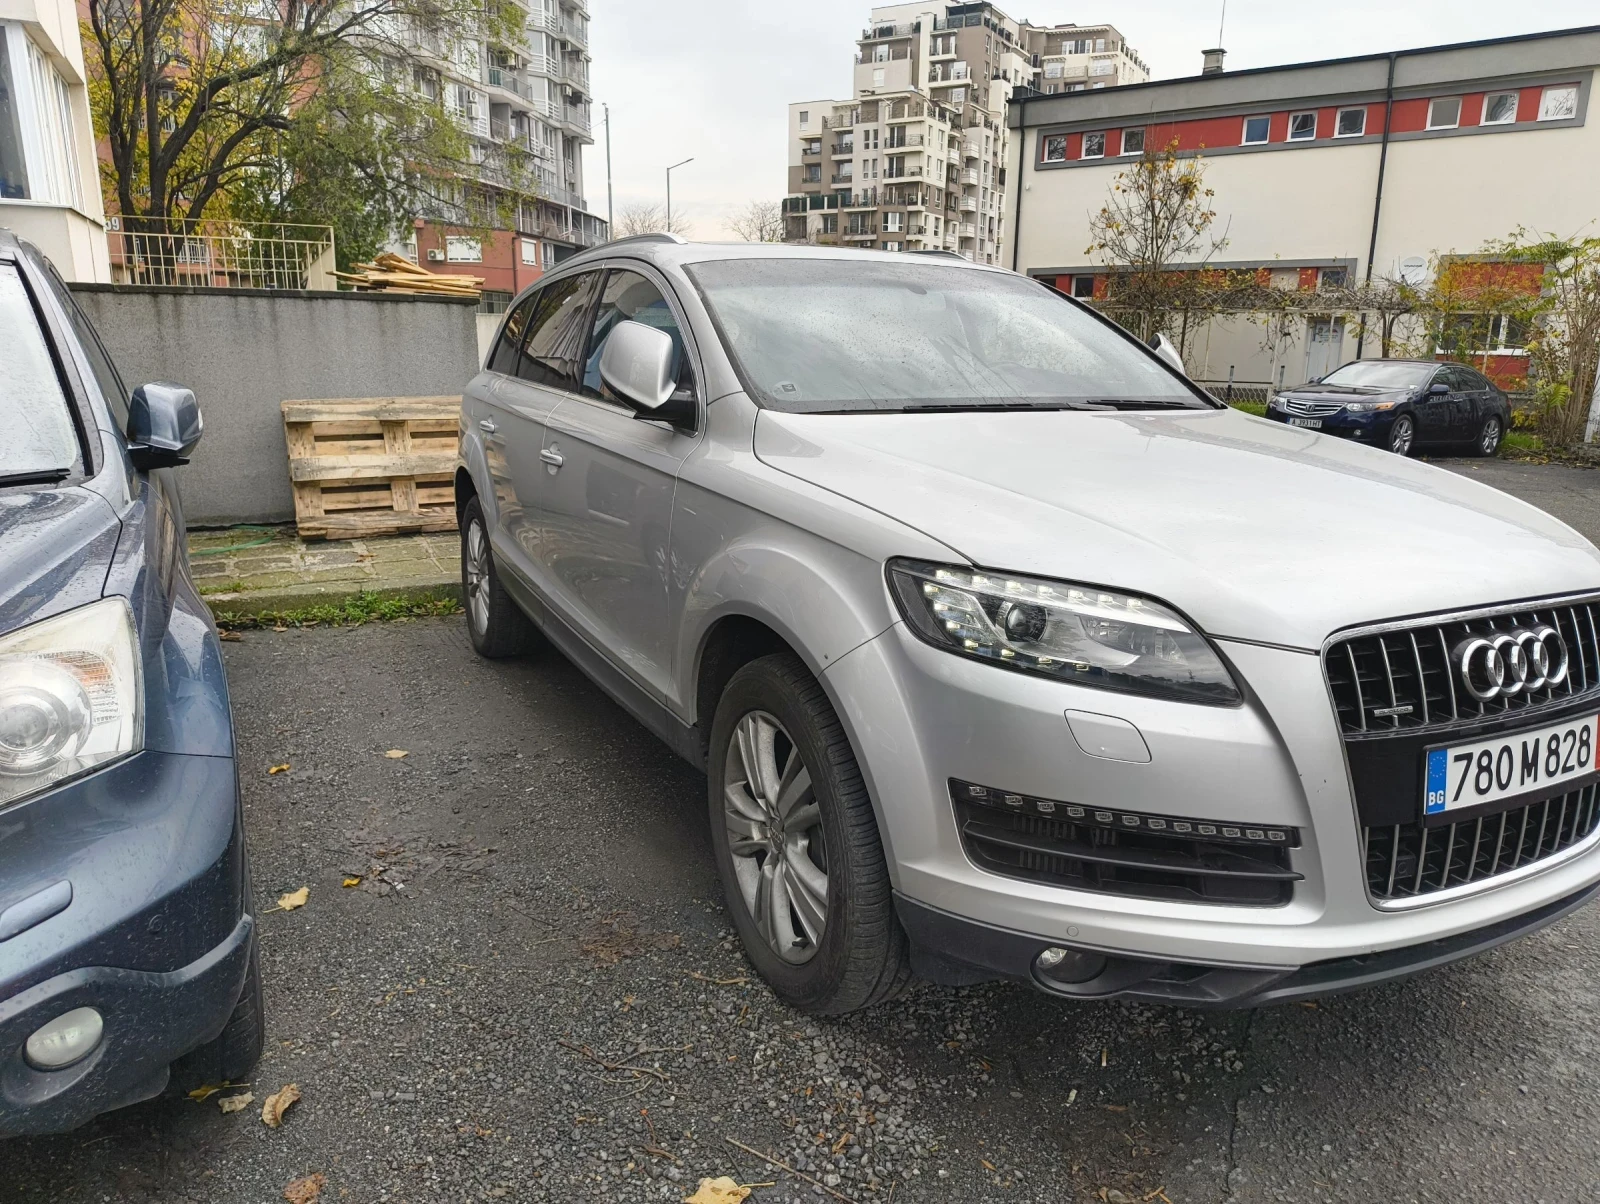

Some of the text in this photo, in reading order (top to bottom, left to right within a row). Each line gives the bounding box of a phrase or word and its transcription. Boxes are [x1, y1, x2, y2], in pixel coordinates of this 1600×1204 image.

[1452, 724, 1591, 802] 780 M 828
[1428, 790, 1445, 806] BG
